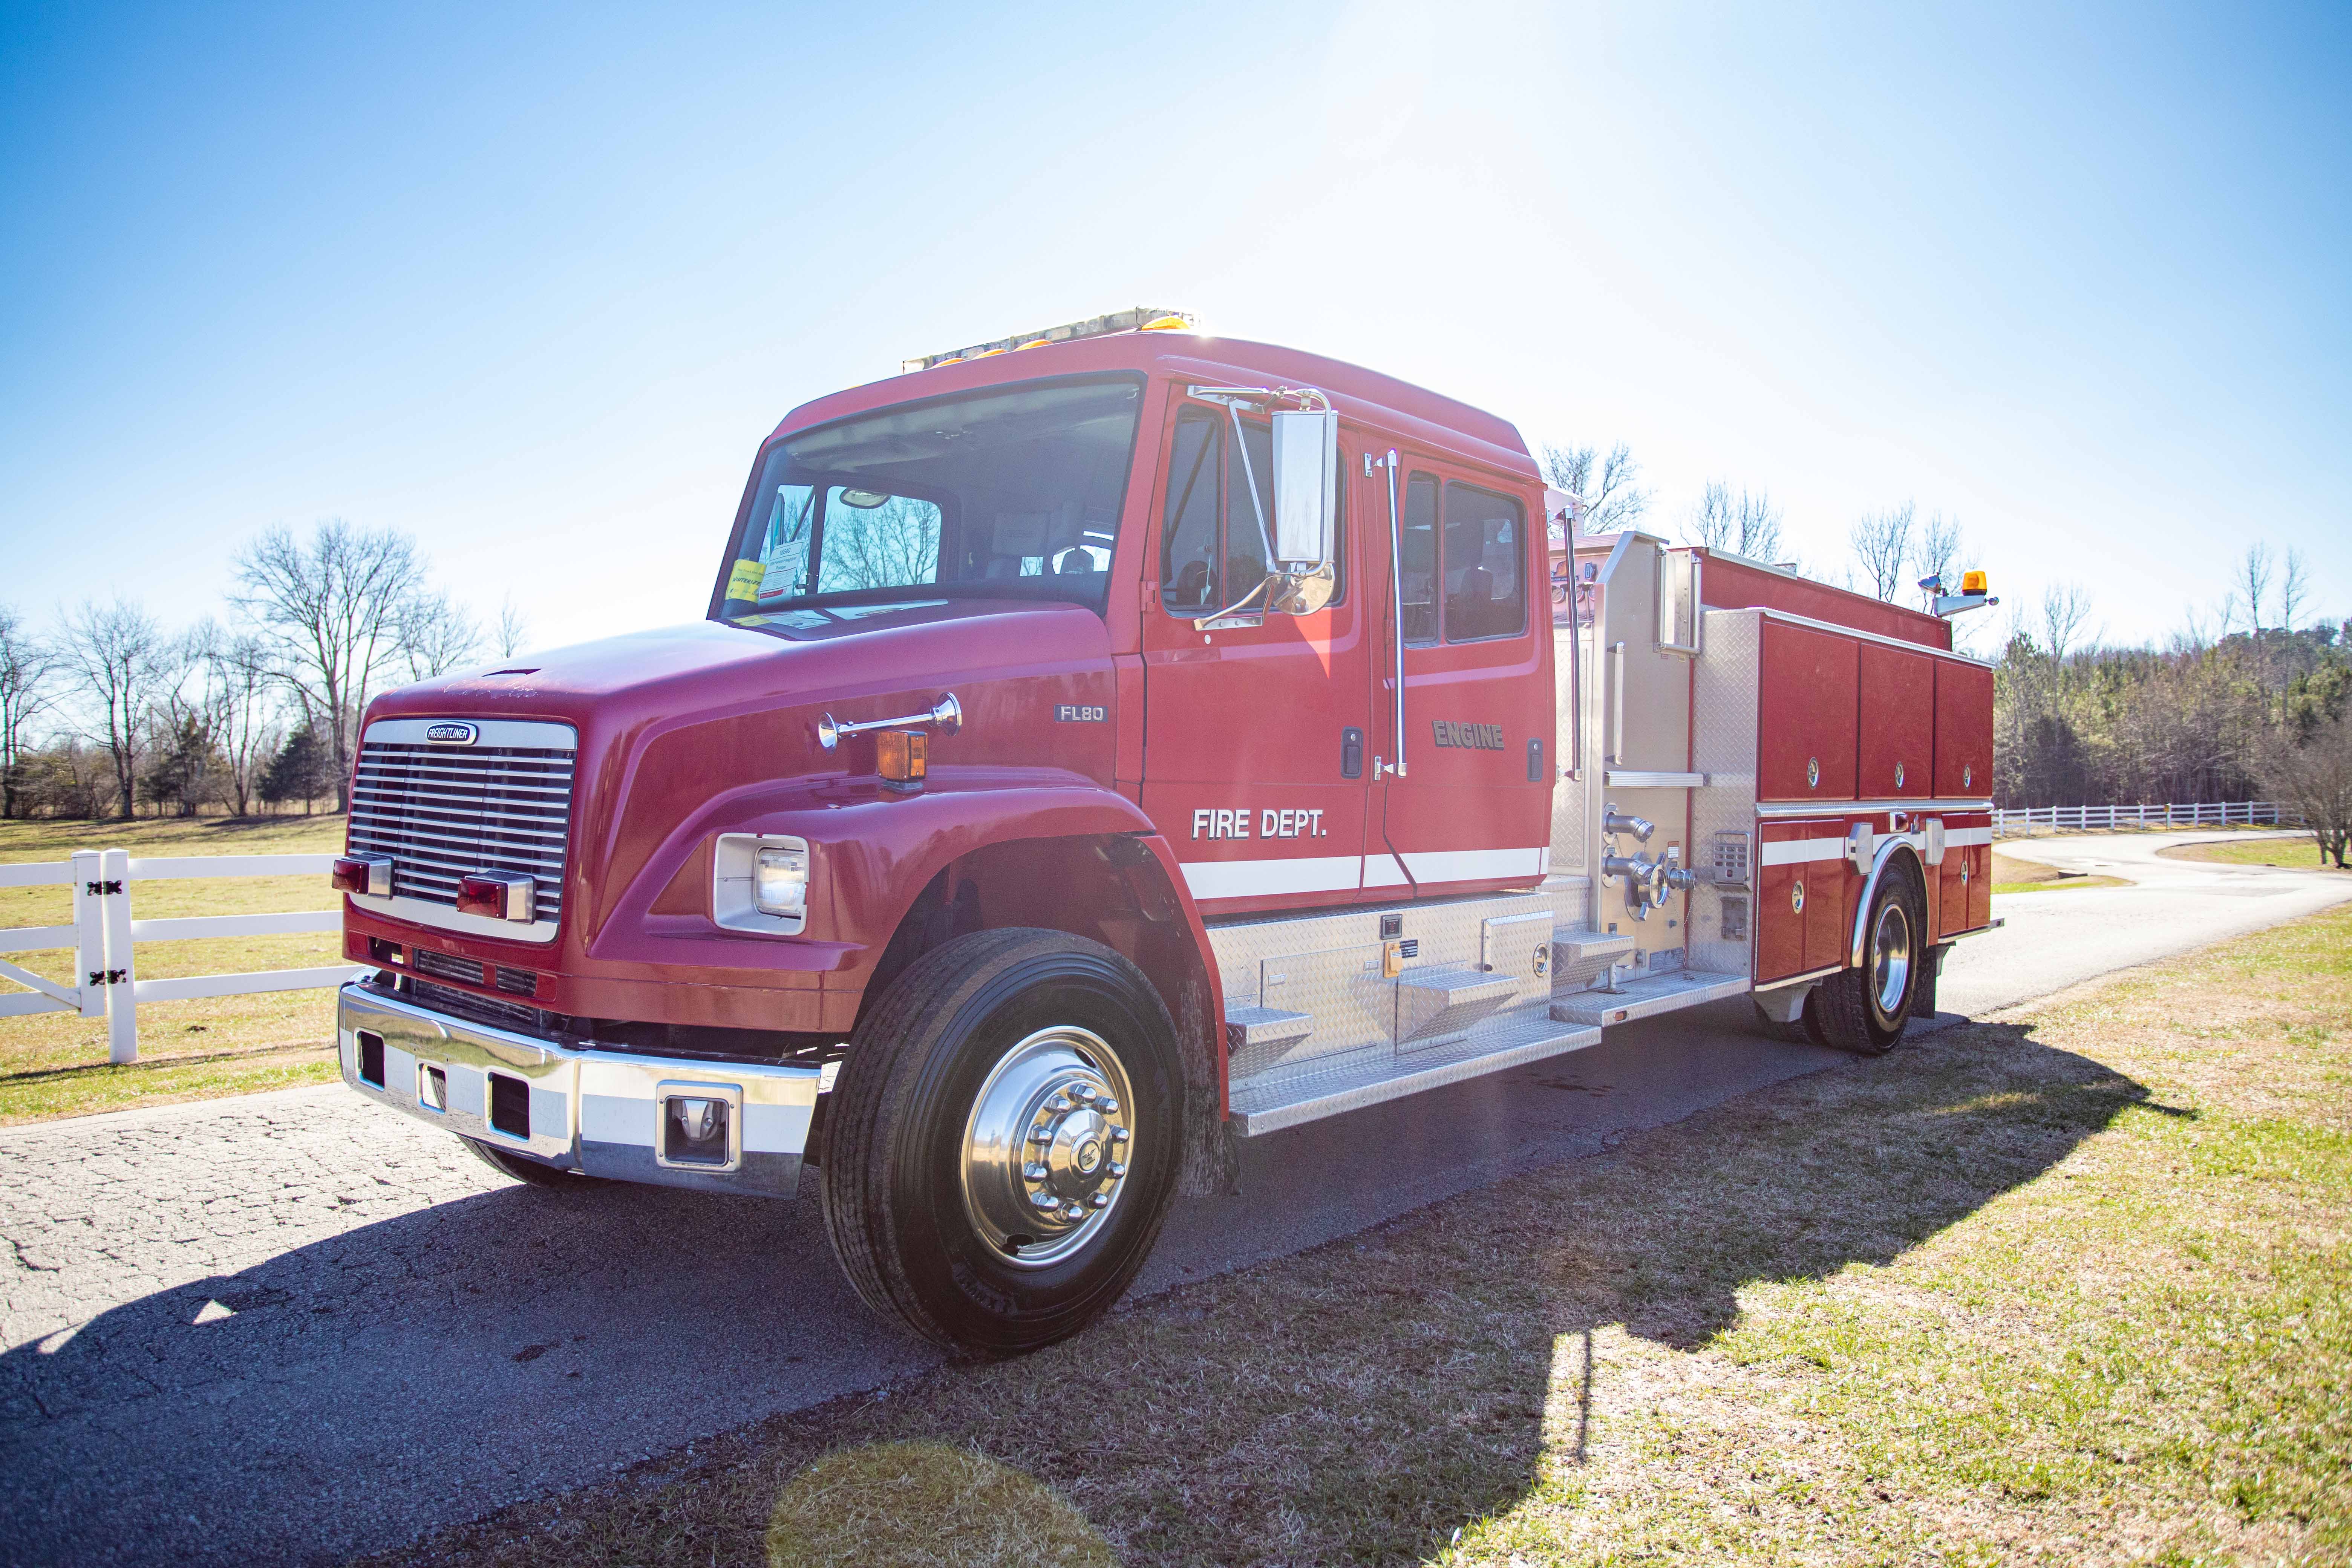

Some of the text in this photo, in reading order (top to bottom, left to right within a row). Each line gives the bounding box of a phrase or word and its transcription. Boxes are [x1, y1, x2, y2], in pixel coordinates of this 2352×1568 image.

[732, 576, 761, 586] WINTERIZE
[1061, 706, 1103, 721] FL80
[428, 727, 468, 739] FREIGHTLINER
[1432, 720, 1504, 750] ENGINE
[1191, 809, 1327, 841] FIRE DEPT.
